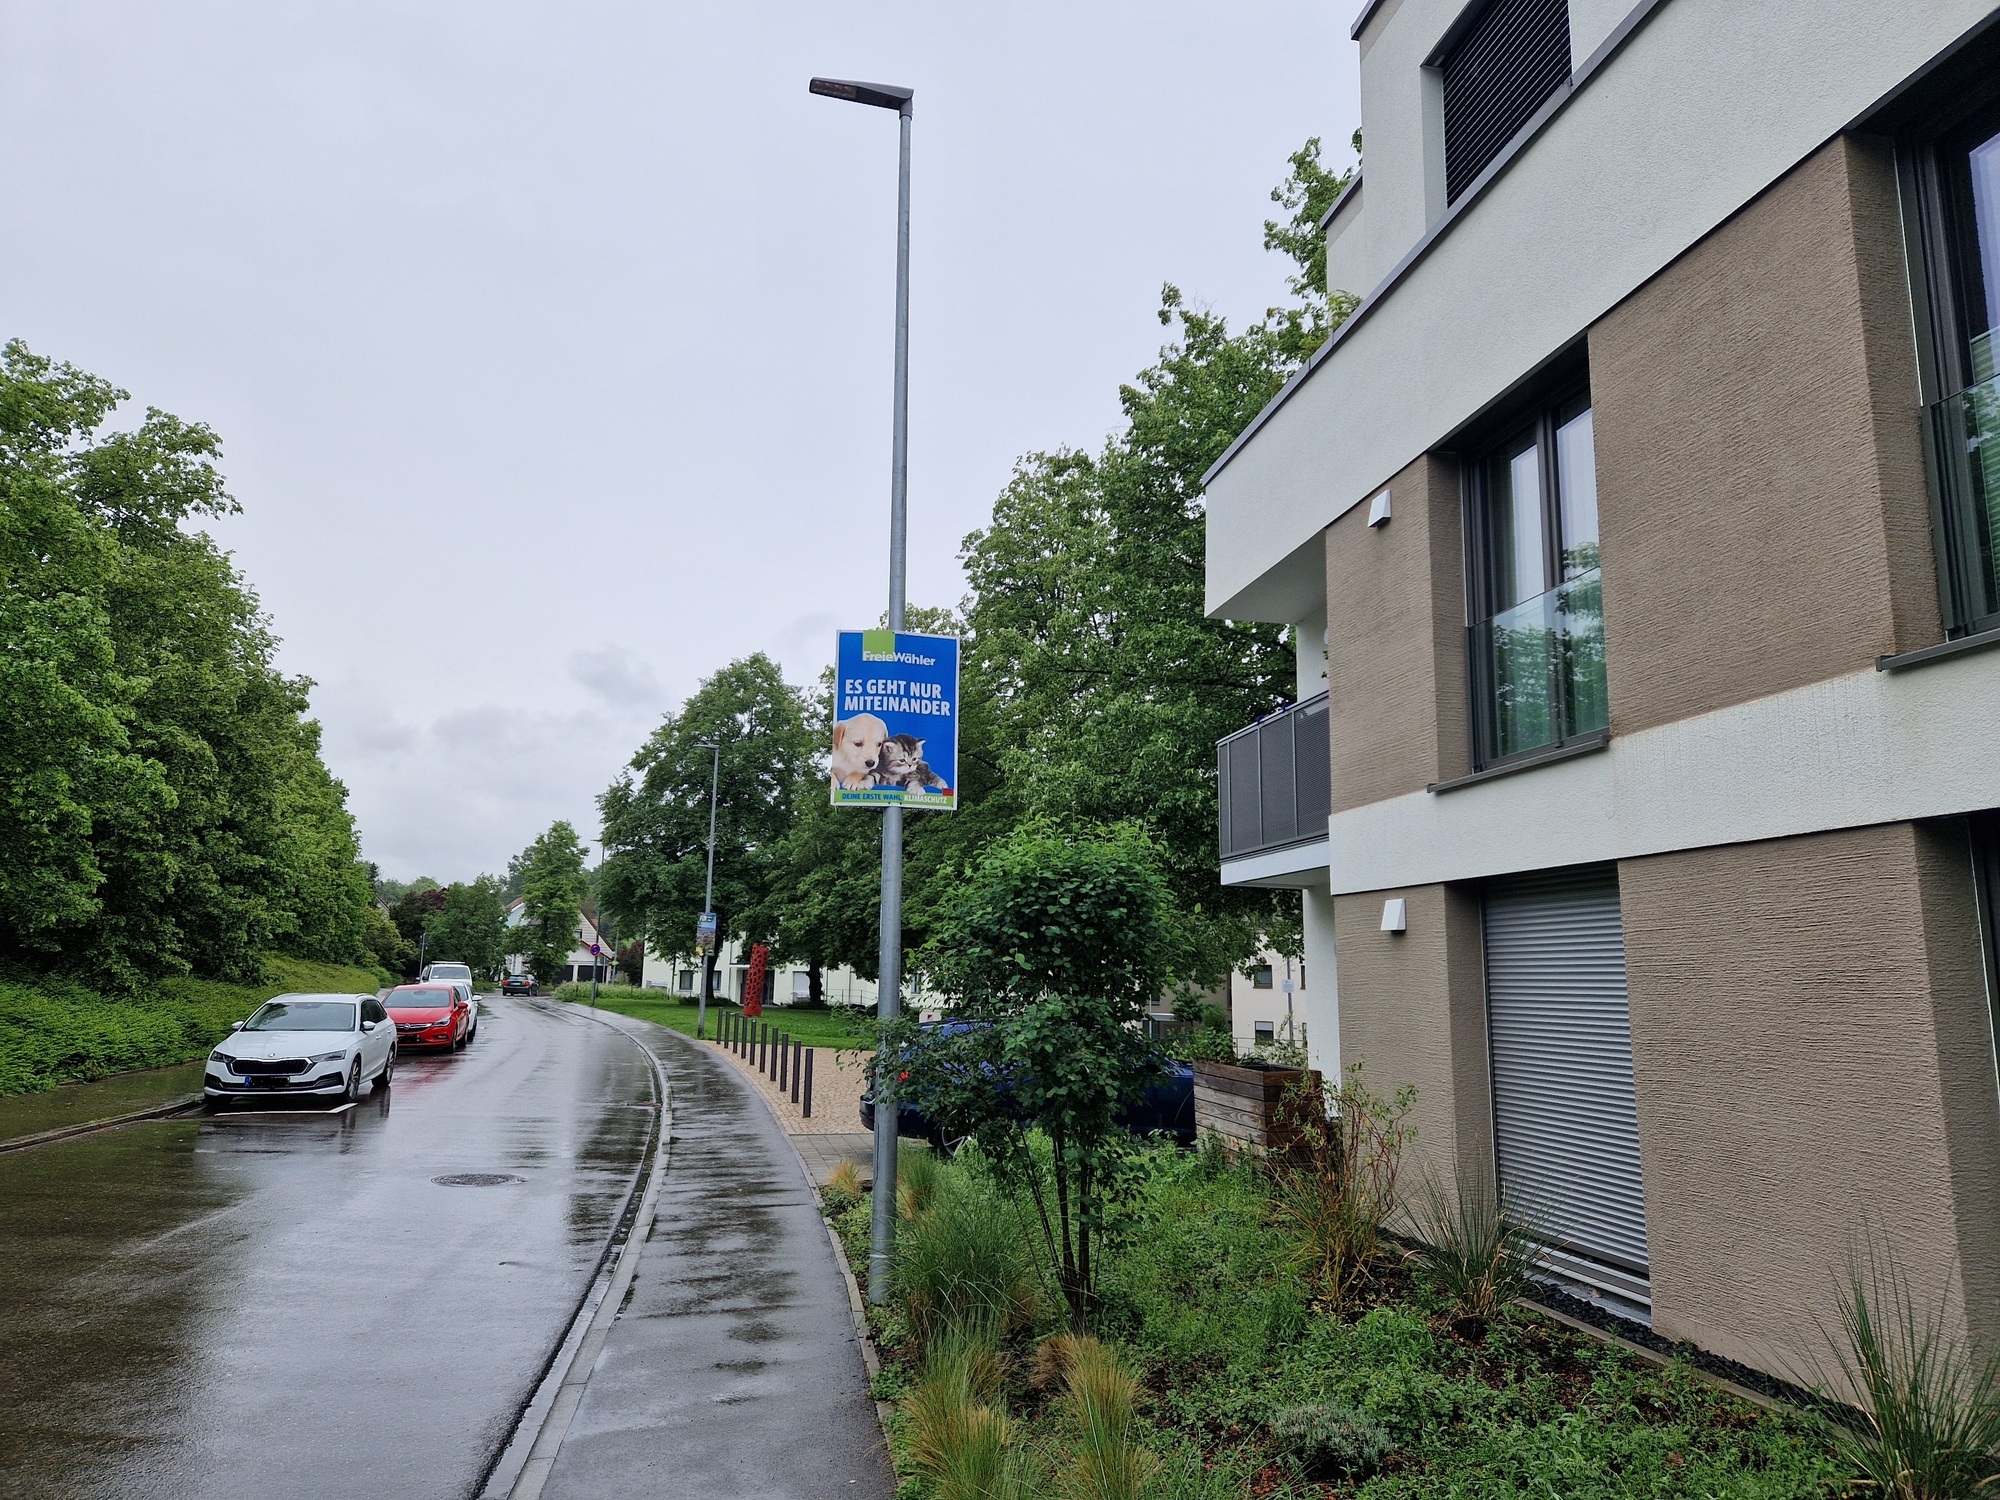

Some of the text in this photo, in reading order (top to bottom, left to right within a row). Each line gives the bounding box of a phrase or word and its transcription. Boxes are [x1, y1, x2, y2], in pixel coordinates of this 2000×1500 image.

[863, 651, 936, 665] FreieWähler
[845, 679, 941, 698] ES GEHT NUR
[845, 696, 950, 716] MITEINANDER
[904, 795, 947, 804] KLIMASCHUTZ
